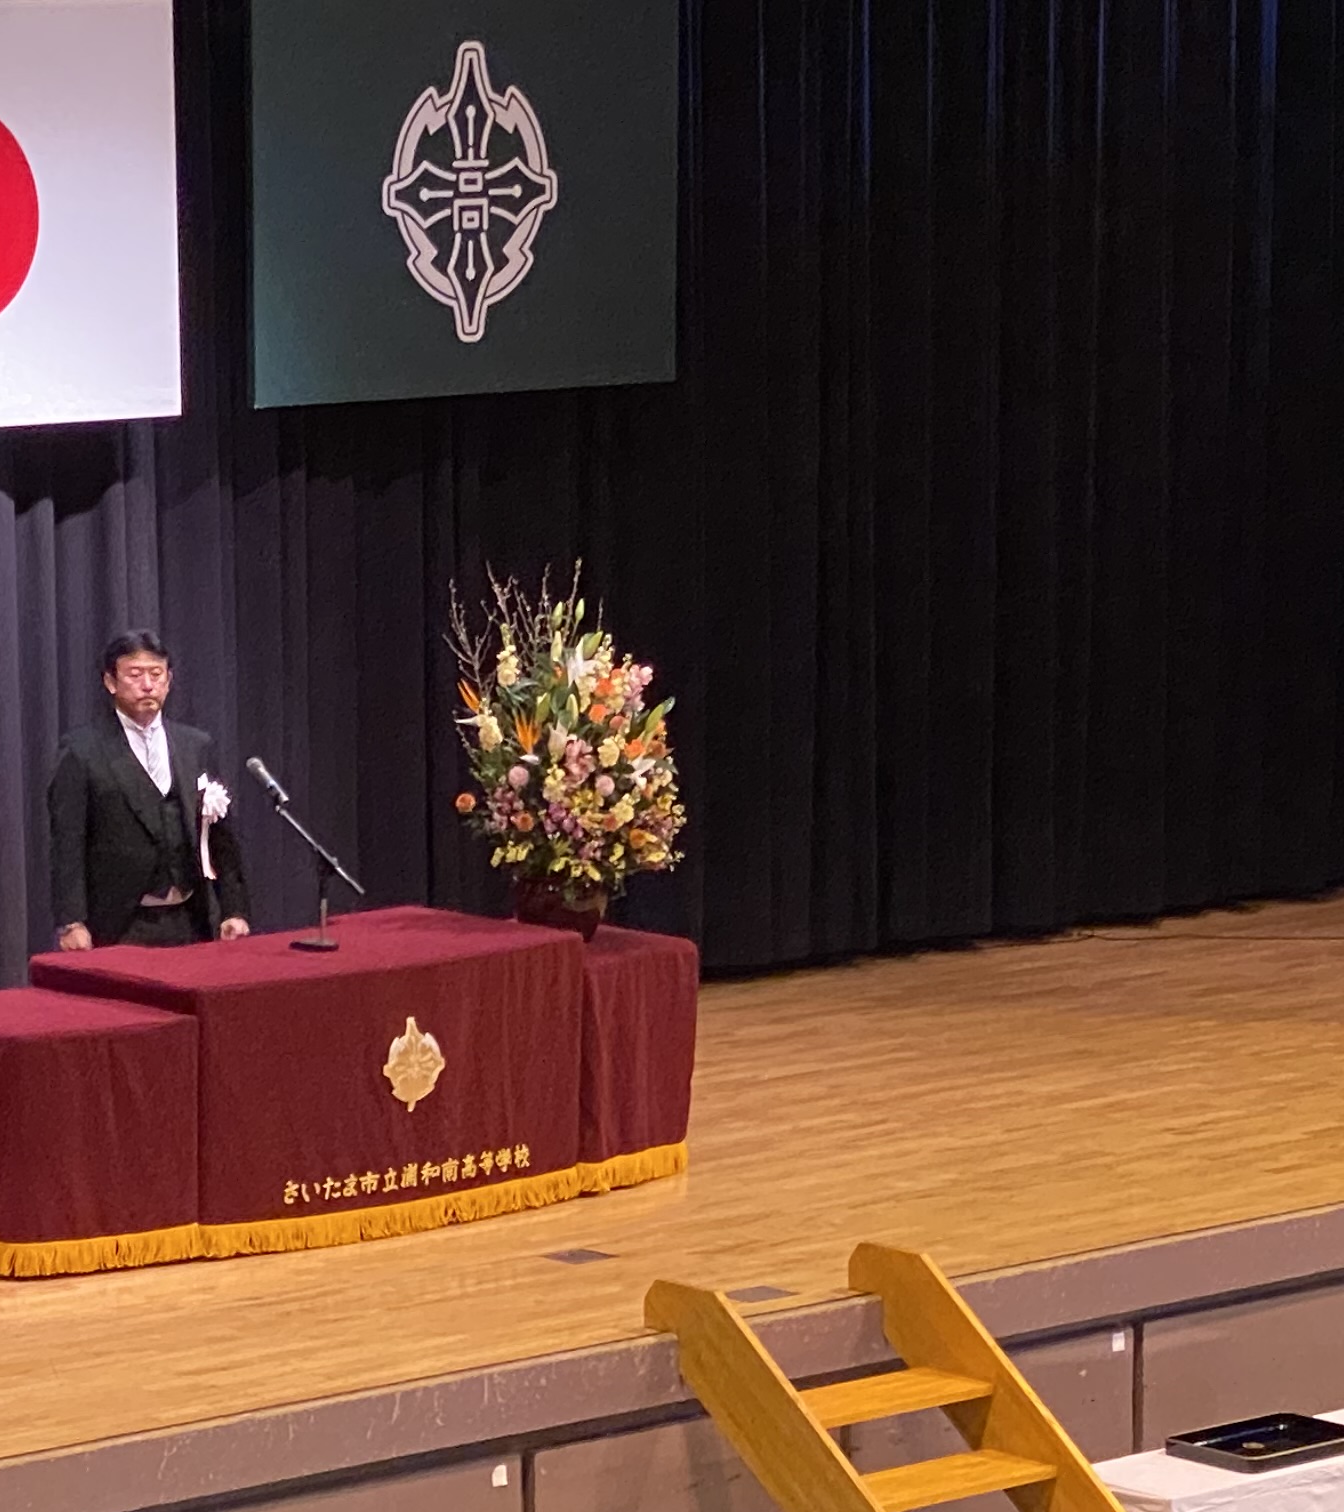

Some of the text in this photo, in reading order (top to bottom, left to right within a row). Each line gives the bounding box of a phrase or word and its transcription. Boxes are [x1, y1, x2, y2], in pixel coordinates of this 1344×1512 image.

[283, 1143, 530, 1204] さいたま市立浦和南高等学校
